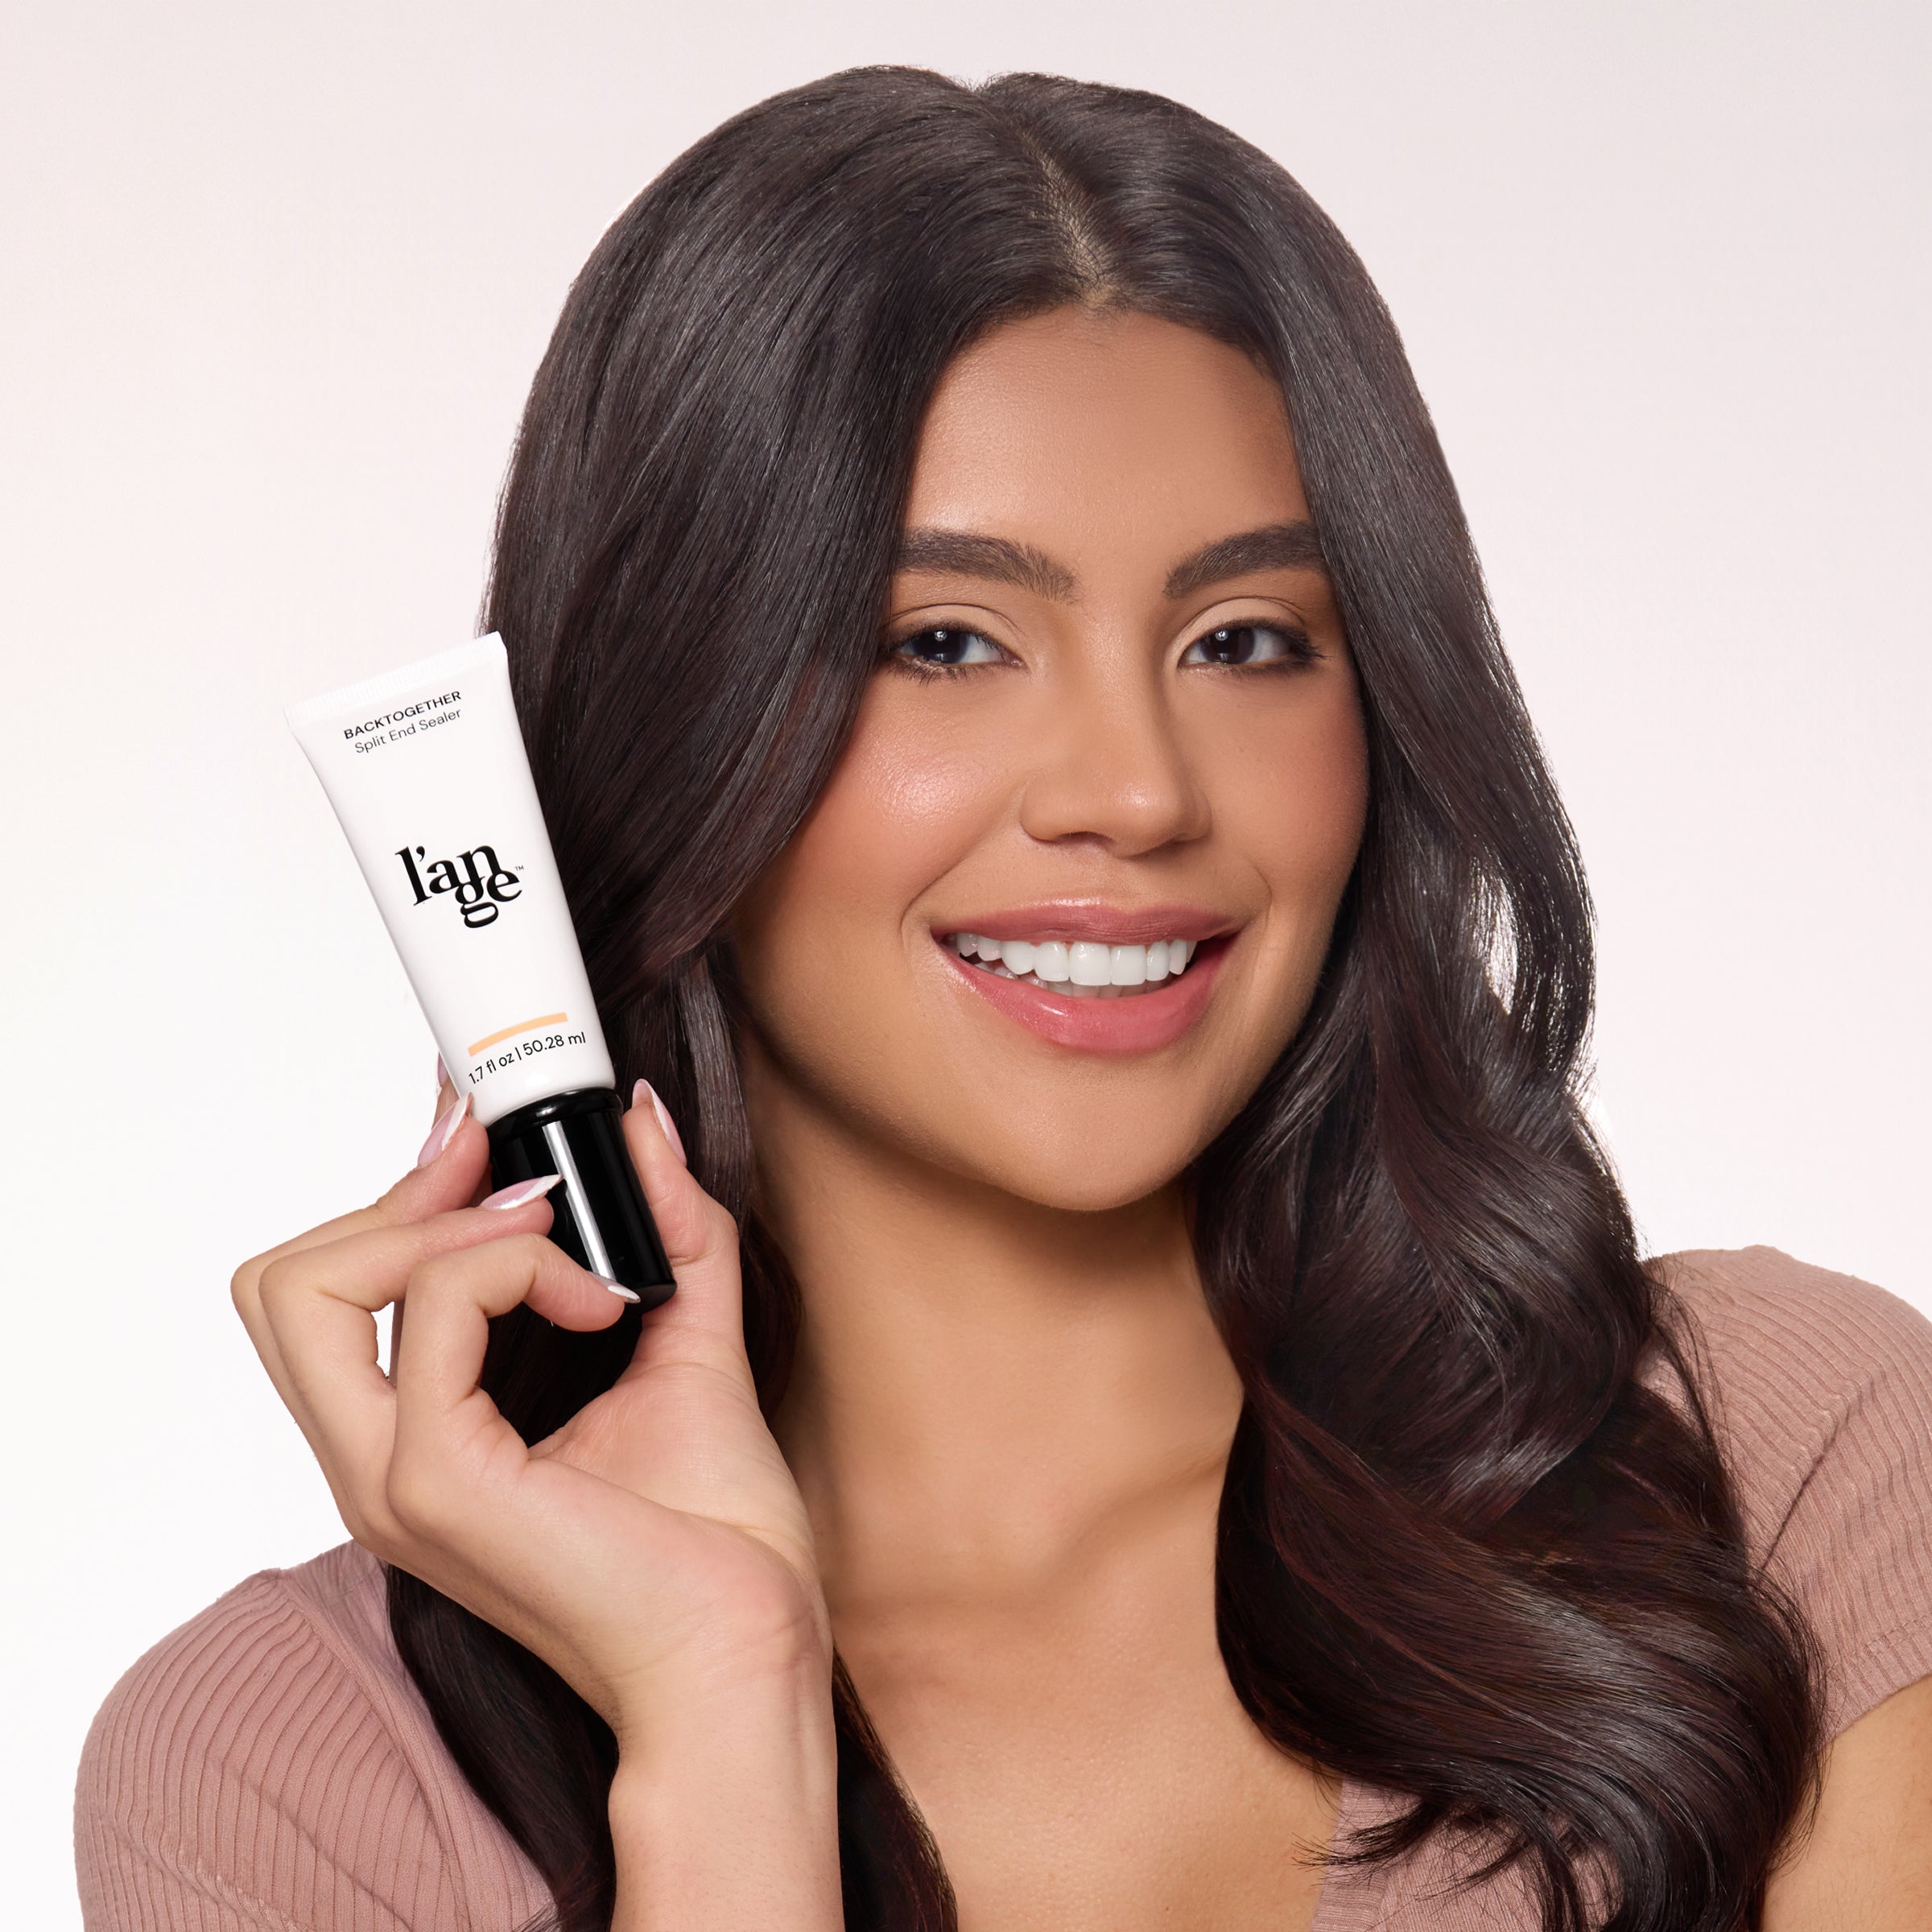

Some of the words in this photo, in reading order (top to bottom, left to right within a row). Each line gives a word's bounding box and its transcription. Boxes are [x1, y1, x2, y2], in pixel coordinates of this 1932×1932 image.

[344, 691, 461, 740] BACKTOGETHER
[354, 735, 386, 753] Split
[389, 723, 416, 742] End
[419, 709, 461, 732] Sealer
[468, 1065, 483, 1085] 1.7
[486, 1059, 497, 1074] fl
[498, 1052, 516, 1067] oz
[522, 1034, 565, 1056] 50.28
[568, 1030, 586, 1045] ml
